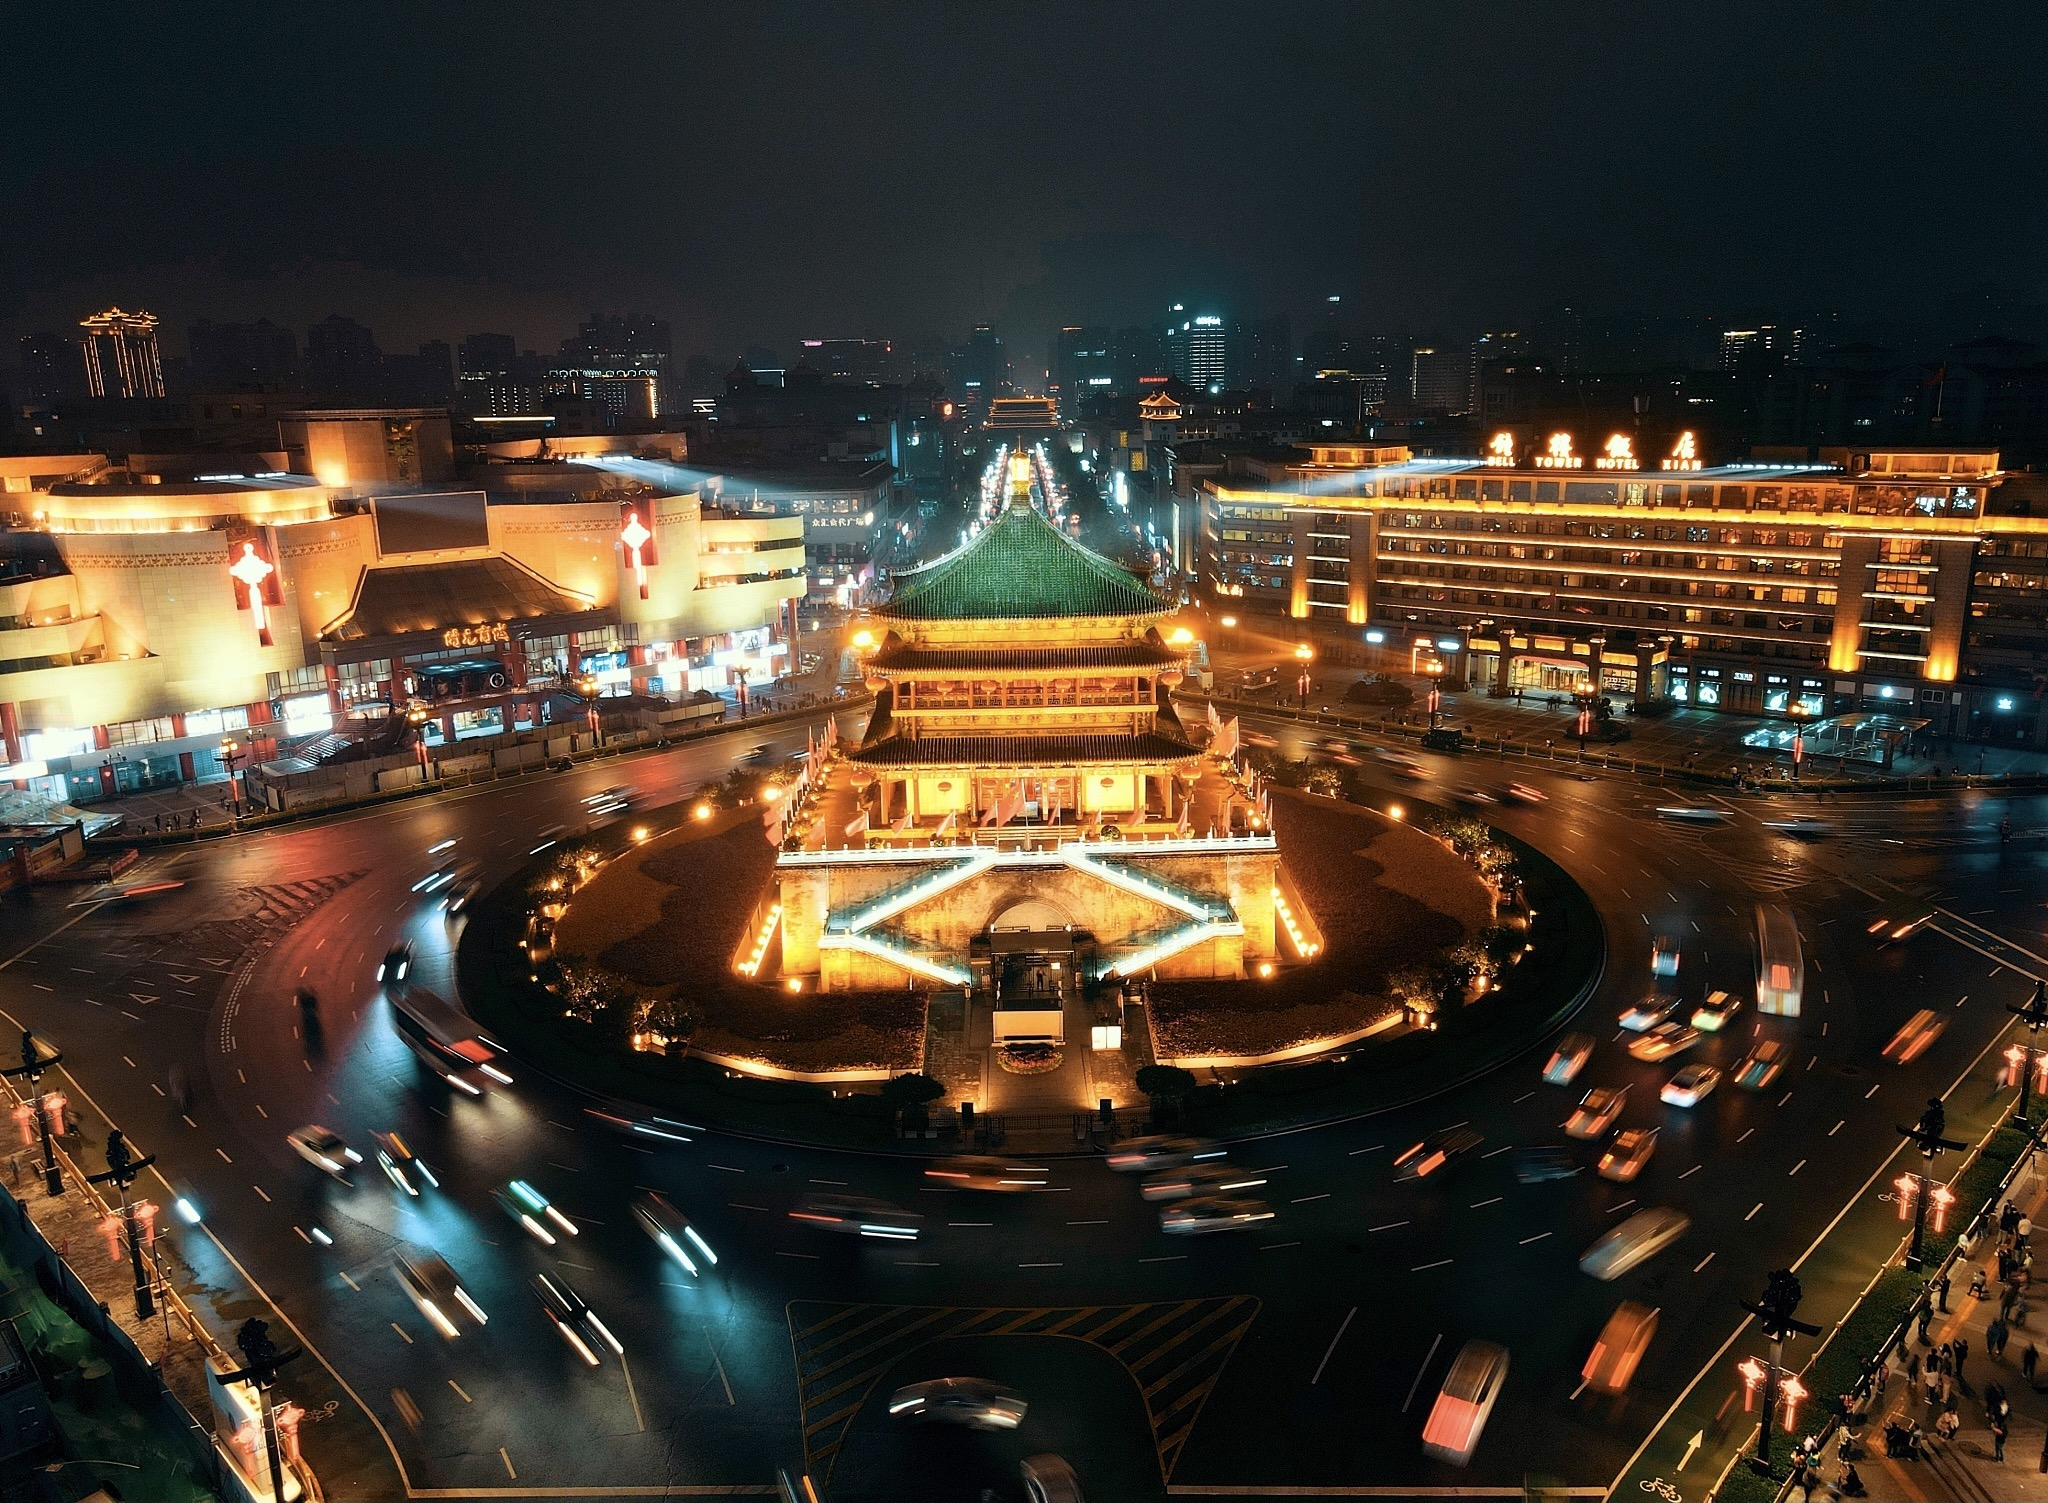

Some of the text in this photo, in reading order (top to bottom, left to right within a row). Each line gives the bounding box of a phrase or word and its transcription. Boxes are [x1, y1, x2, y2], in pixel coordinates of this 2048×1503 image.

[1487, 456, 1703, 471] BELL TOWER HOTEL XIAN
